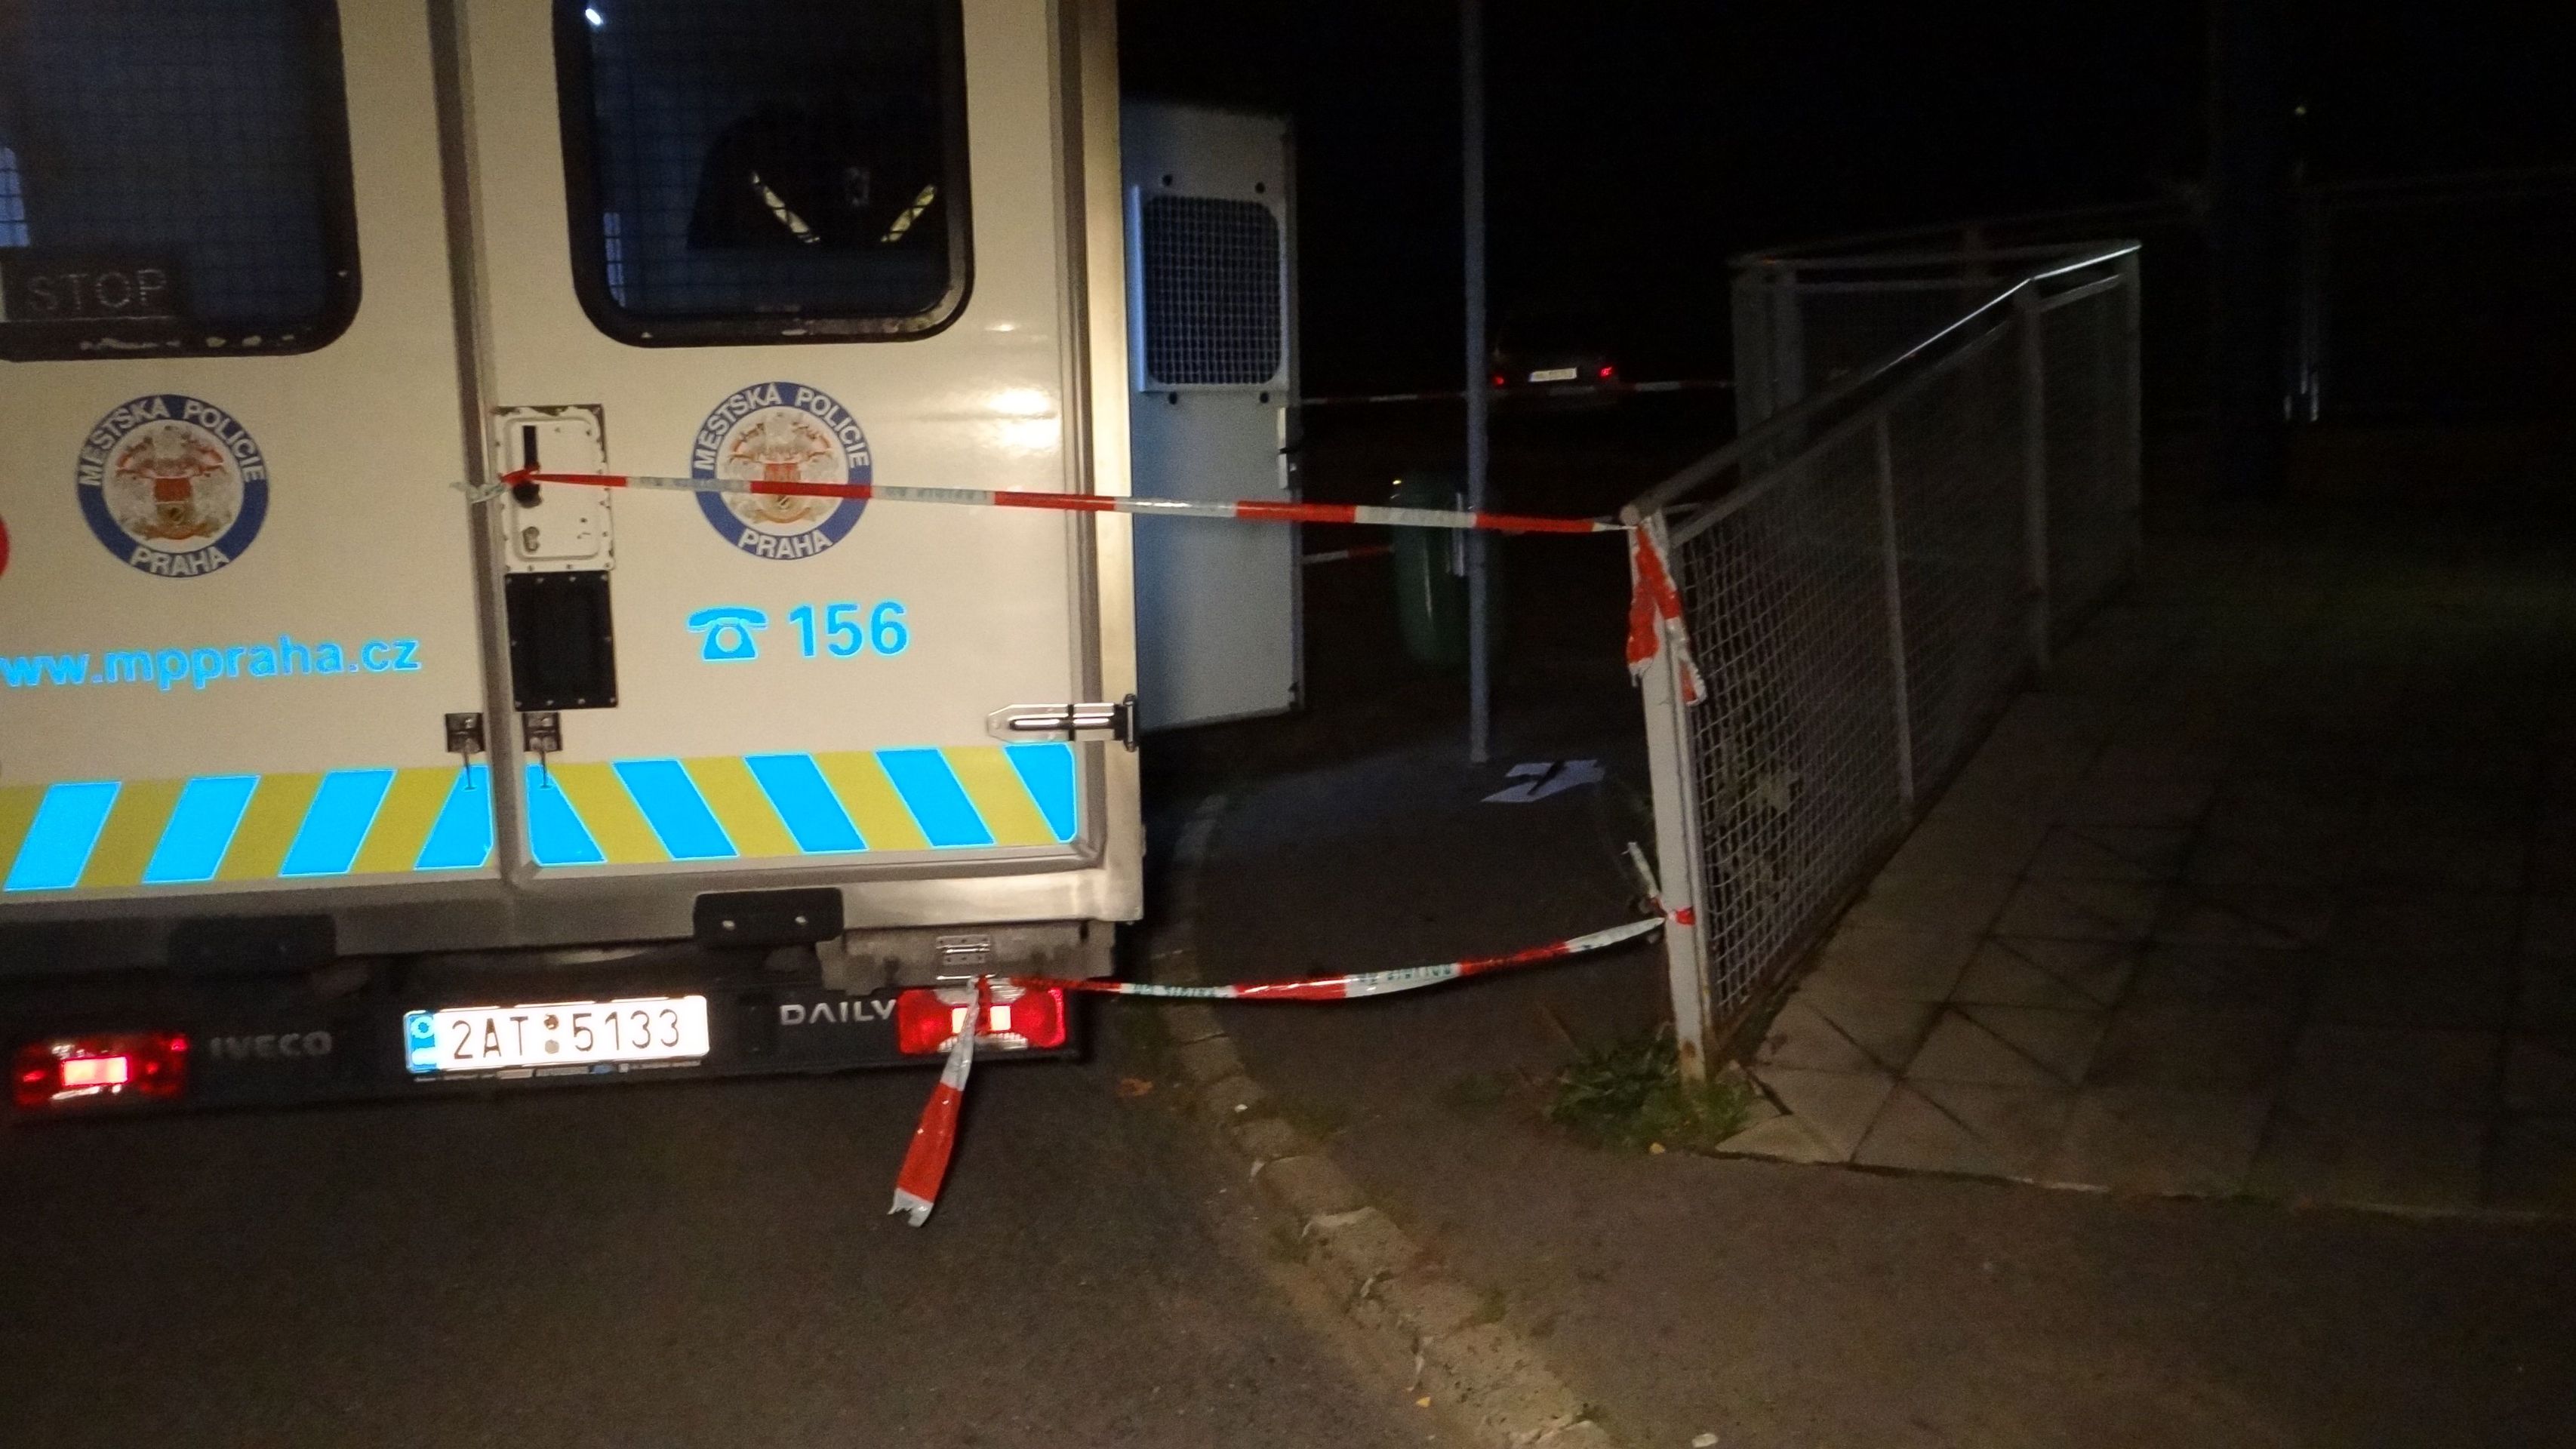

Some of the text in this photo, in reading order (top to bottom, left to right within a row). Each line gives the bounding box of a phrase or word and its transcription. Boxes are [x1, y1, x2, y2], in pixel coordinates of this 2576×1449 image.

[28, 269, 167, 310] STOP
[183, 399, 266, 483] POLICIE
[795, 386, 869, 469] POLICIE
[130, 546, 229, 576] PRAHA
[738, 528, 833, 559] PRAHA
[789, 600, 908, 657] 156
[780, 998, 897, 1026] DAILY
[210, 1030, 333, 1059] IVECO
[452, 1008, 680, 1060] 2AT 5133
